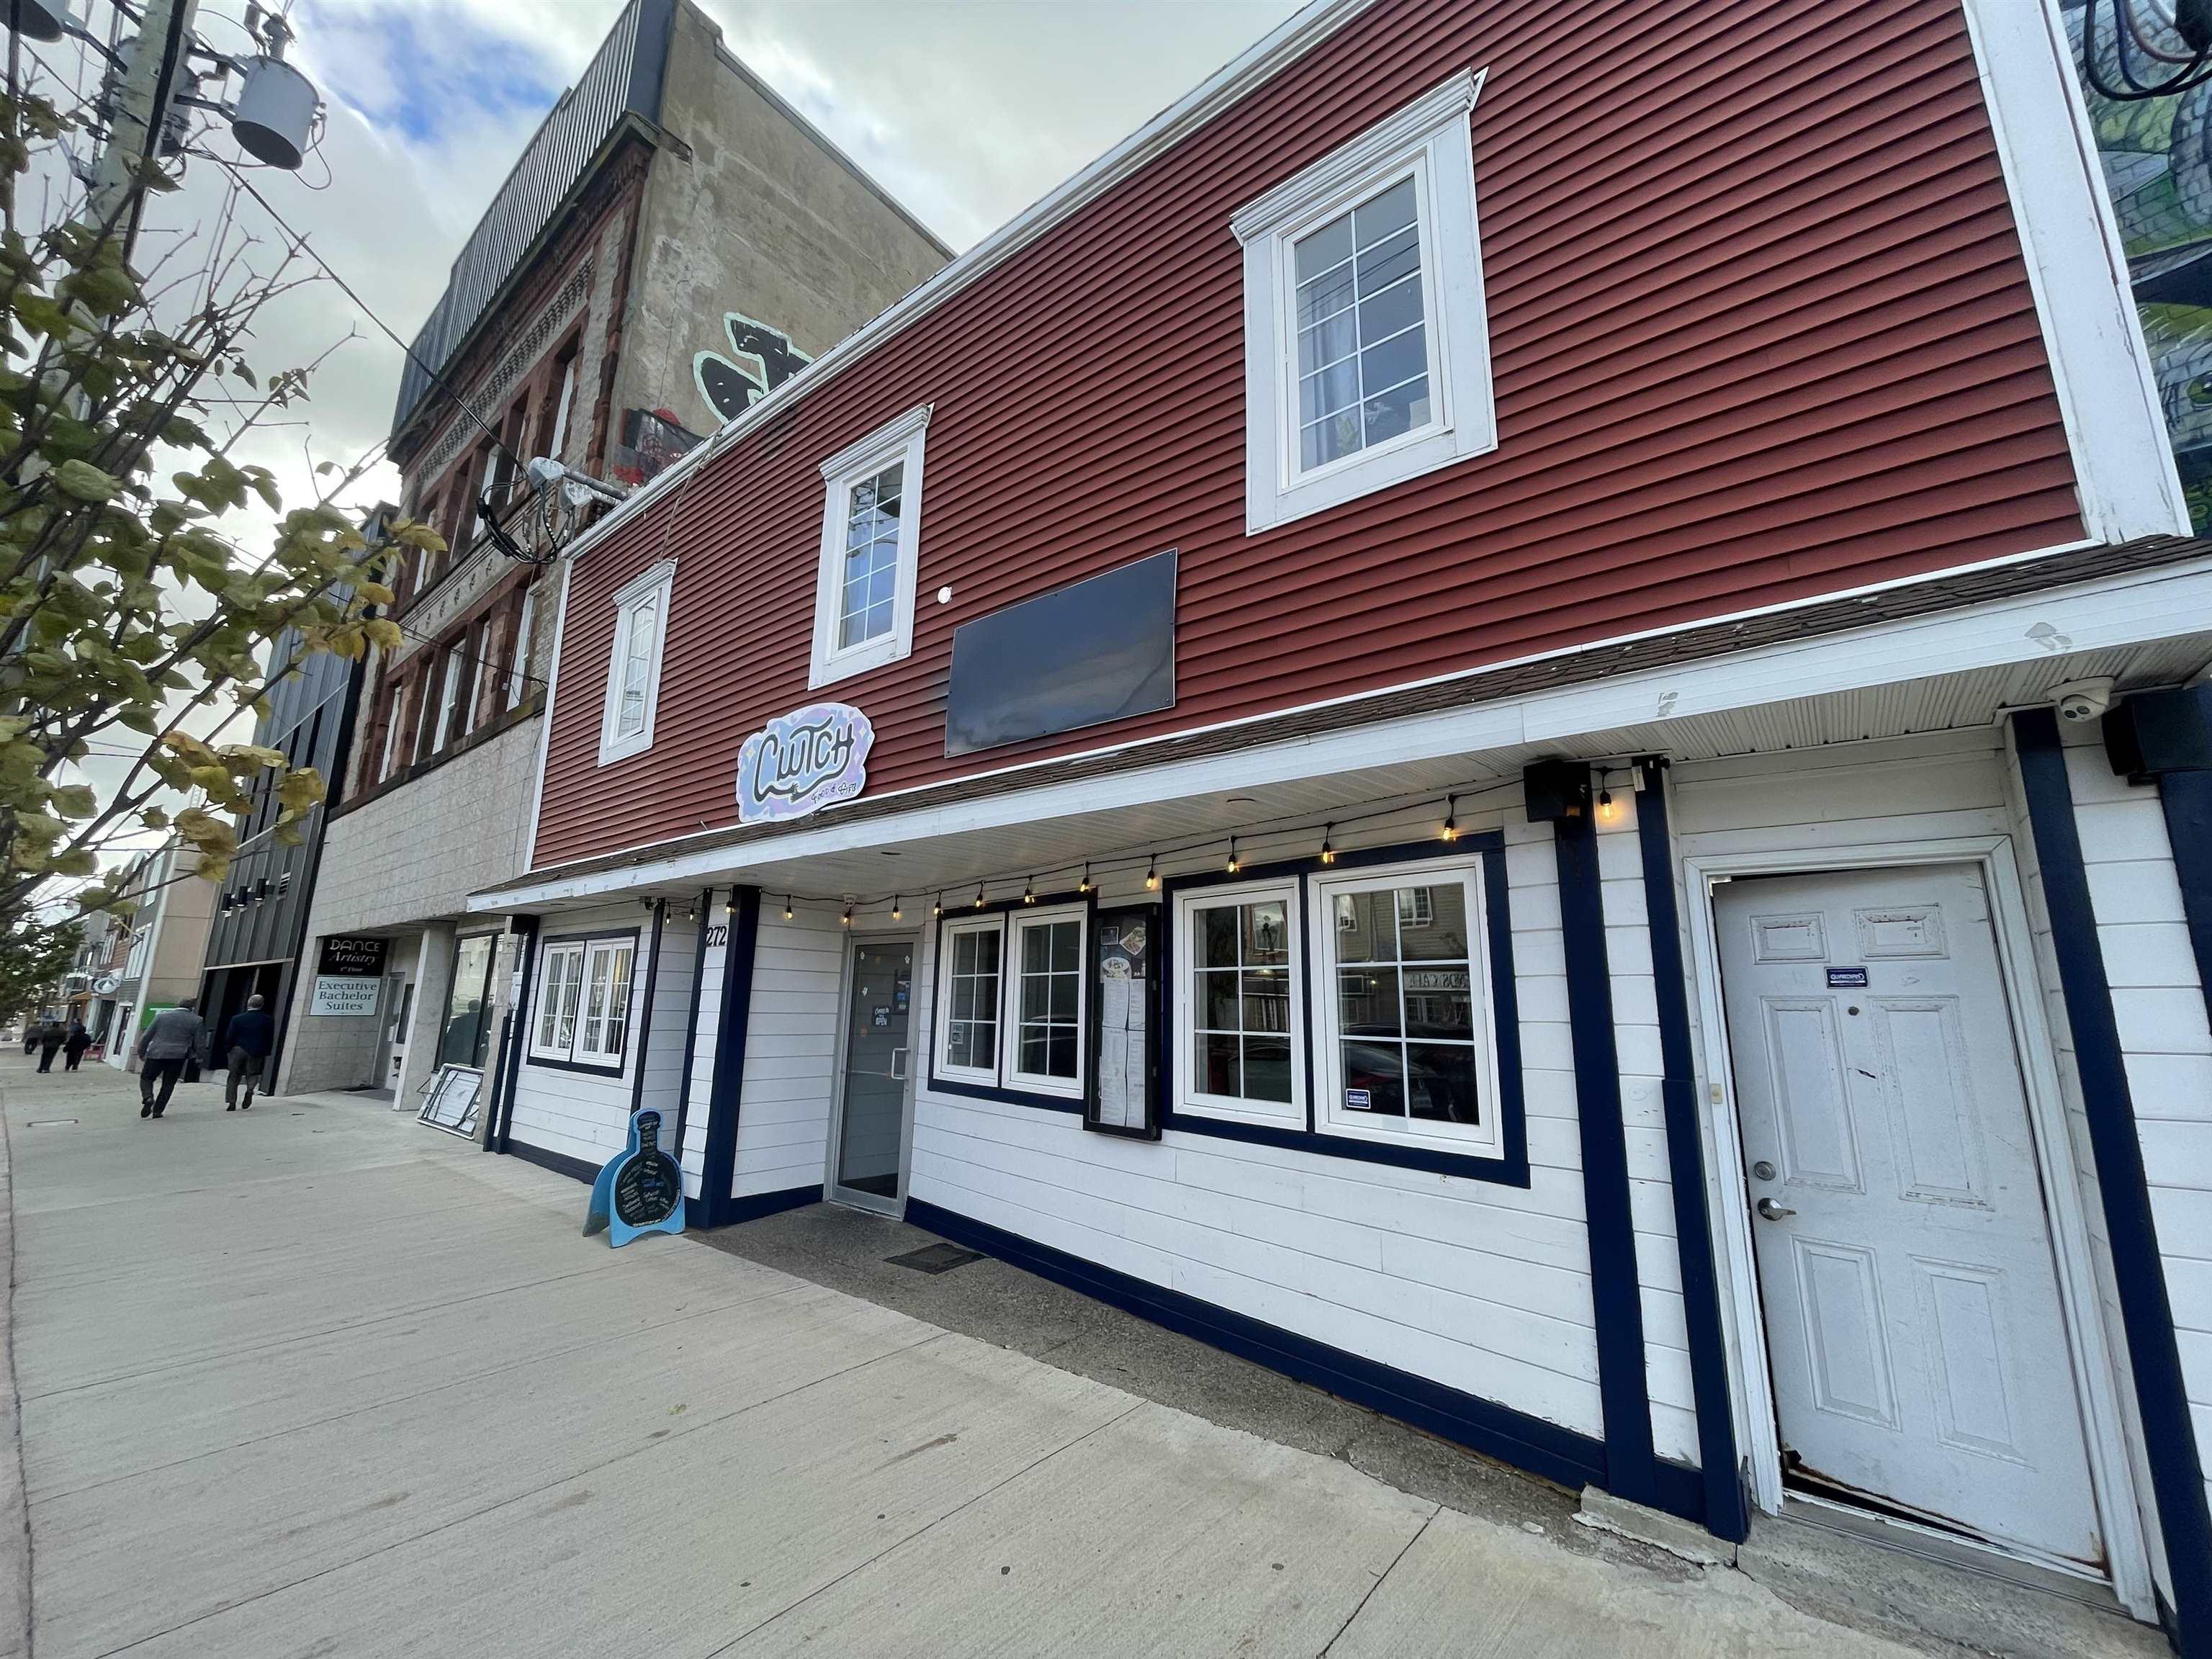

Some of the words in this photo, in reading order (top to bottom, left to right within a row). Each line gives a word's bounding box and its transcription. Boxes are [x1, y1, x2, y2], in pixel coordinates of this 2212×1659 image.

[754, 716, 855, 802] CLUTCH
[706, 925, 727, 946] 272
[330, 939, 380, 952] DANCE
[328, 951, 376, 966] Artistry
[318, 981, 377, 991] Executive
[319, 991, 373, 1000] Bachelor
[325, 1002, 363, 1010] Suites
